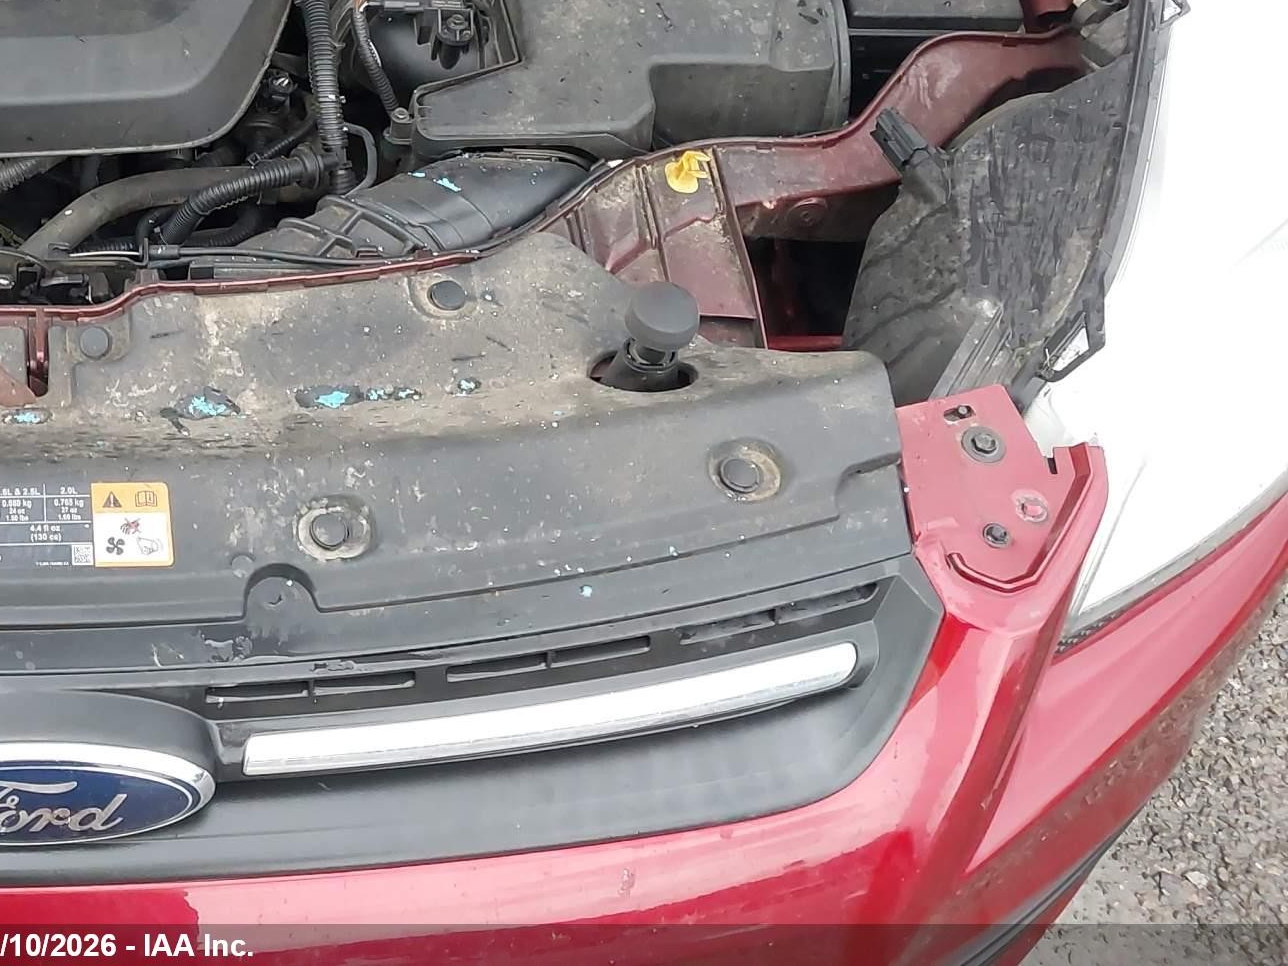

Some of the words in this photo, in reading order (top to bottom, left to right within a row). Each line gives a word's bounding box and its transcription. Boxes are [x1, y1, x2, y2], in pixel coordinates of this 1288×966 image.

[60, 486, 78, 494] 2.0L
[22, 499, 32, 509] kg
[75, 498, 84, 508] kg
[29, 524, 42, 532] 4.4
